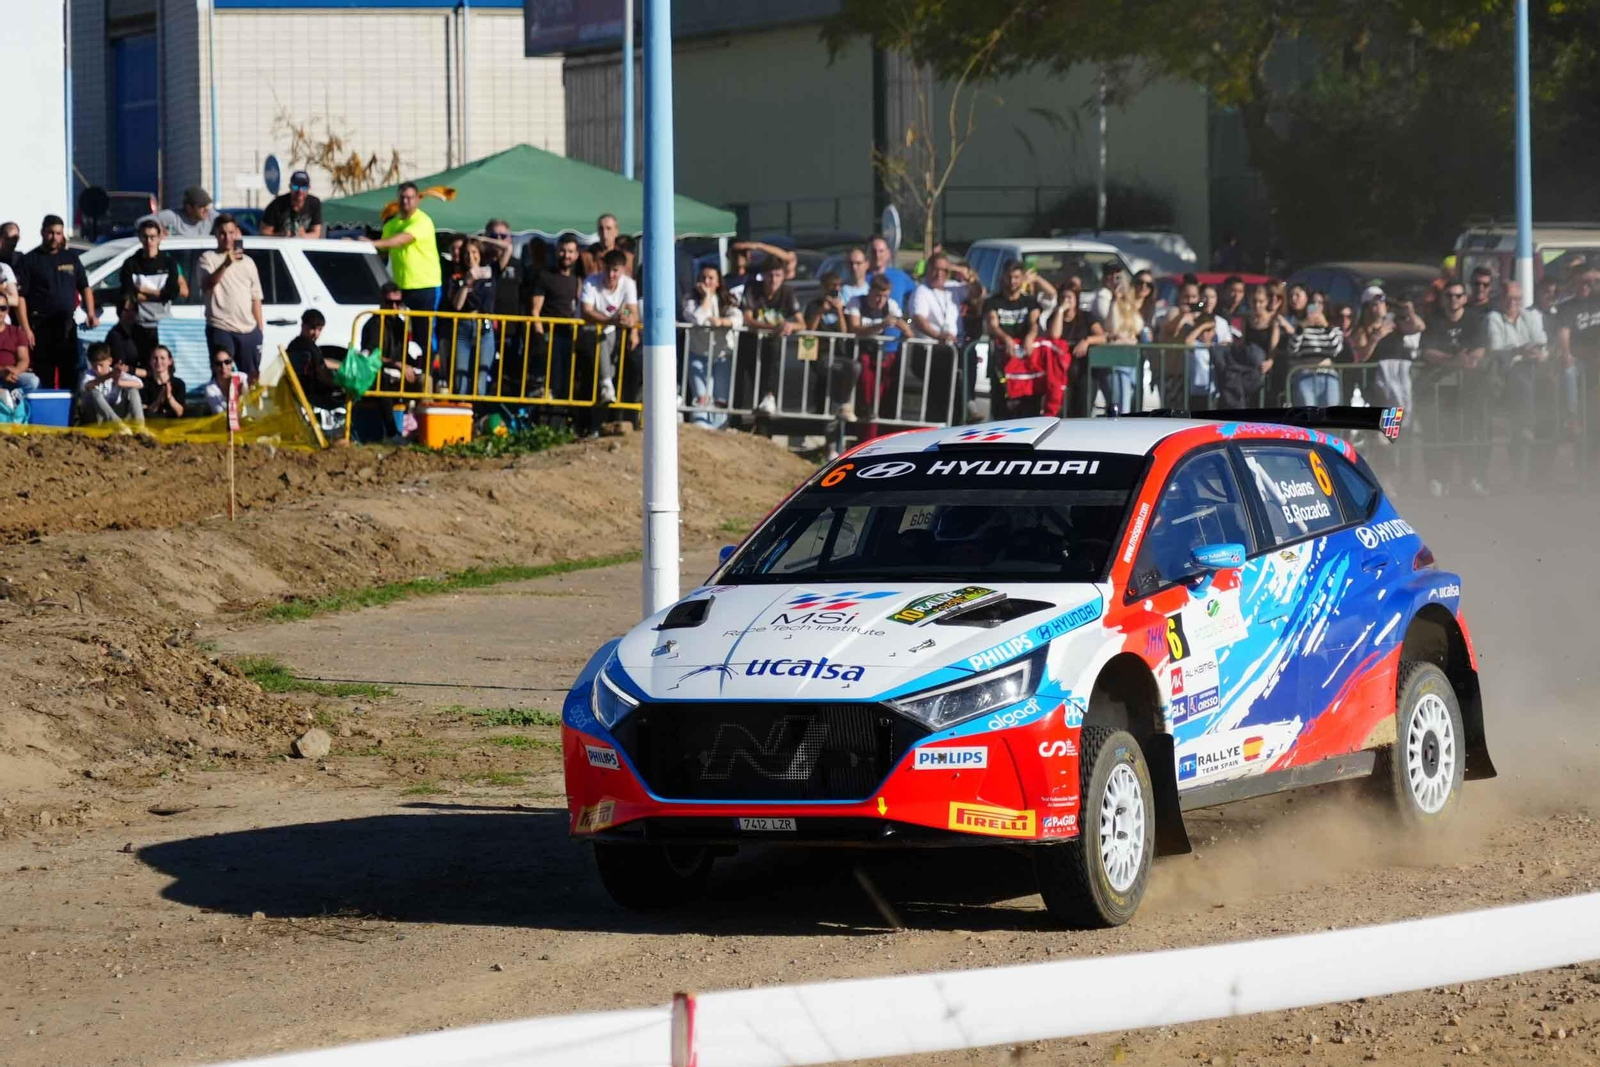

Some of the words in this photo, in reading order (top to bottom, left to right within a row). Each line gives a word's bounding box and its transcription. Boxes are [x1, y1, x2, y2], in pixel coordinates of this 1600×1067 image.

[820, 463, 855, 487] 6
[926, 460, 1100, 475] HYUNDAI
[1309, 450, 1332, 497] 6
[1275, 480, 1316, 499] .Solans
[1281, 499, 1331, 524] B.Rozada
[1439, 584, 1460, 598] ucalsa
[894, 609, 925, 622] 10
[912, 590, 962, 613] RALLYE
[1054, 603, 1098, 633] HYUNDAI
[722, 626, 767, 638] Race
[773, 624, 811, 632] Tech
[815, 624, 886, 637] Institute
[1166, 618, 1183, 660] 6
[968, 634, 1034, 672] PHILIPS
[745, 656, 866, 683] ucalsa
[588, 750, 617, 765] PHILIPS
[919, 751, 983, 764] PHILIPS
[1197, 746, 1241, 766] RALLYE
[1202, 764, 1219, 774] TEAM
[1220, 760, 1239, 770] SPAIN
[744, 819, 767, 830] 7412
[772, 819, 792, 830] LZR
[956, 808, 1028, 830] PIRELLI
